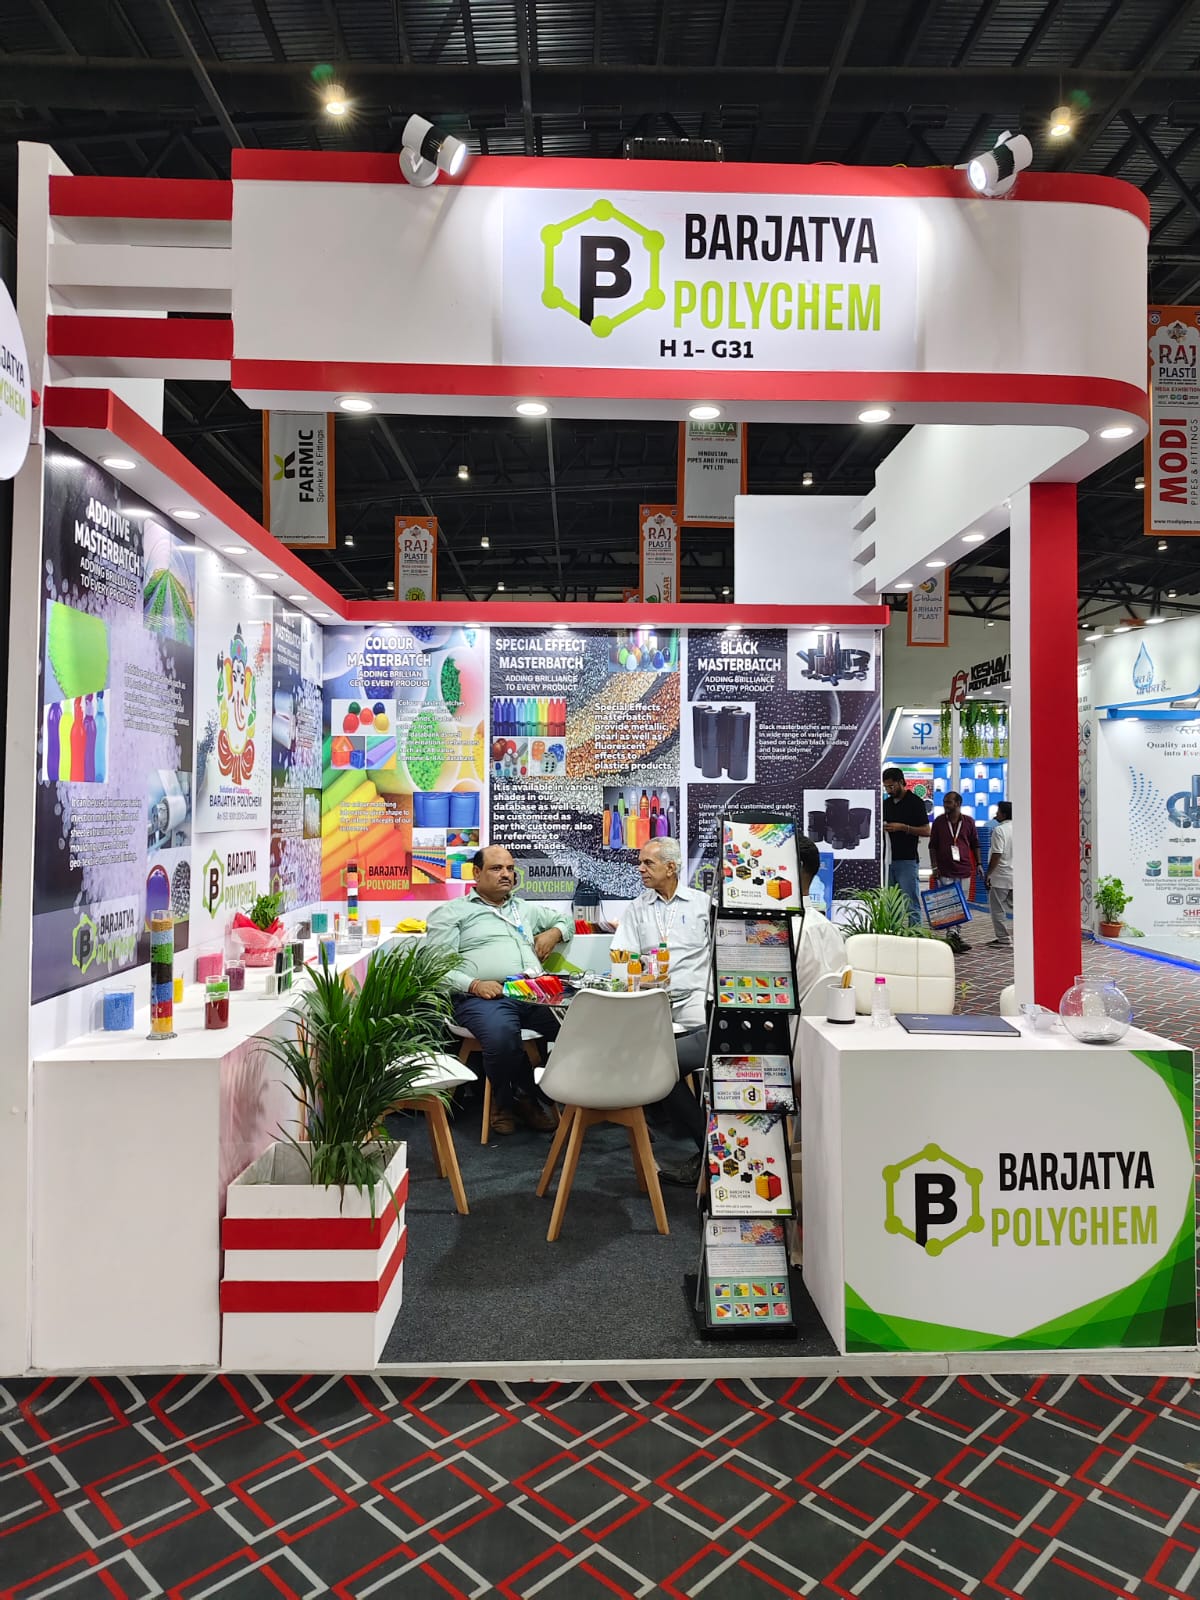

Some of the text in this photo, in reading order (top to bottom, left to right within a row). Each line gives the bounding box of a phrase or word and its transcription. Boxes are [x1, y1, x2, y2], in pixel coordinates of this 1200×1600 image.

[685, 213, 879, 264] BARJATYA
[673, 280, 881, 331] POLYCHEM
[711, 341, 754, 359] G31
[1159, 344, 1197, 367] RAJ
[316, 429, 325, 458] Fittings
[1191, 418, 1199, 466] FITTINGS
[299, 430, 314, 503] FARMIC
[1158, 418, 1188, 505] MODI
[316, 470, 325, 503] Sprinkler
[1191, 480, 1199, 506] PIPES
[87, 497, 131, 542] ADDITIVE
[648, 527, 672, 541] RAJ
[74, 519, 140, 577] MASTERBATCH
[404, 539, 428, 553] RAJ
[80, 556, 137, 595] ADDING BRILLIANCE
[80, 573, 90, 589] TO
[90, 578, 109, 597] EVERY
[365, 636, 413, 650] COLOUR
[495, 638, 587, 651] SPECIAL EFFECT
[720, 641, 759, 655] BLACK
[346, 653, 432, 667] MASTERBATCH
[499, 656, 584, 670] MASTERBATCH
[697, 658, 782, 671] MASTERBATCH
[970, 654, 1007, 681] KESHAV
[505, 674, 578, 682] ADDING BRILLIANCE
[594, 703, 661, 711] Special Effects
[594, 712, 652, 721] masterbatch
[594, 722, 669, 732] provide metallic,
[594, 732, 618, 741] pearl
[631, 732, 650, 740] well
[594, 742, 646, 750] fluorescent
[1146, 741, 1198, 749] Quality and
[594, 751, 637, 760] effects to
[594, 761, 673, 771] plastics products.
[511, 783, 553, 791] available
[209, 794, 263, 808] BARJATYA POLYCHEM
[493, 793, 525, 801] shades
[527, 793, 536, 801] in
[385, 810, 402, 818] shape
[493, 803, 536, 811] database
[551, 803, 569, 811] well
[775, 803, 796, 811] grades
[493, 813, 505, 821] be
[506, 812, 559, 821] customized
[493, 822, 593, 832] per the customer, also
[503, 832, 548, 840] reference
[549, 832, 559, 840] to
[533, 842, 567, 850] shades.
[227, 850, 257, 877] BARJATYA
[368, 866, 409, 877] BARJATYA
[528, 866, 573, 878] BARJATYA
[366, 879, 410, 890] POLYCHEM
[526, 880, 574, 893] POLYCHEM
[100, 908, 135, 935] BARJATYA
[999, 1151, 1155, 1191] BARJATYA
[991, 1205, 1158, 1247] POLYCHEM
